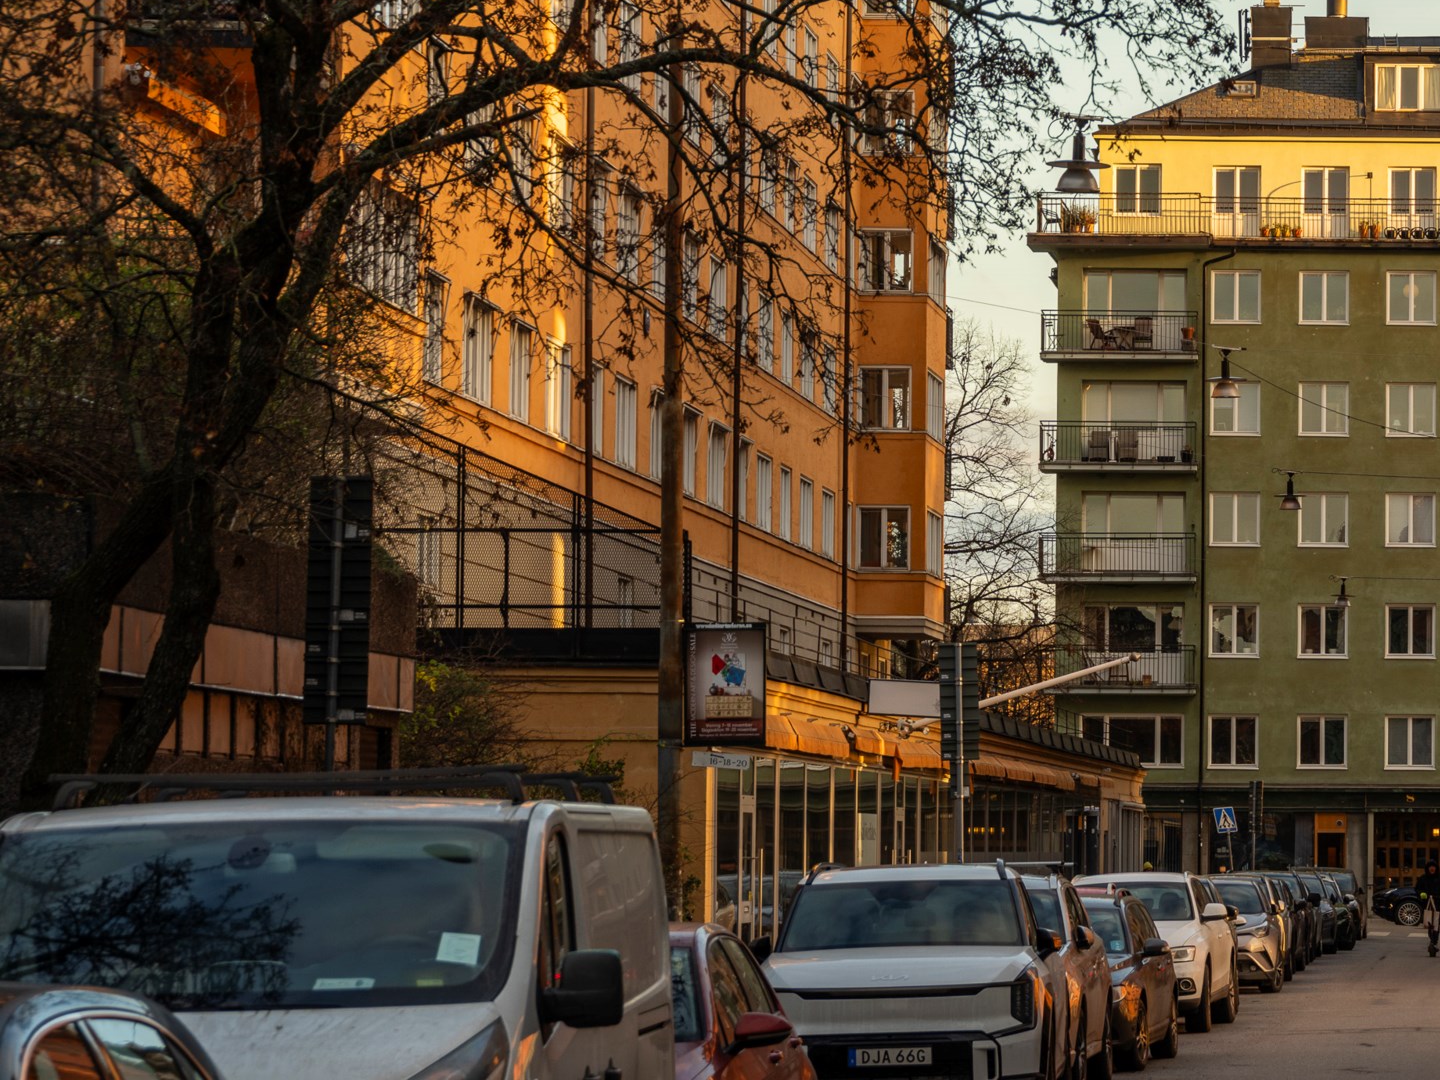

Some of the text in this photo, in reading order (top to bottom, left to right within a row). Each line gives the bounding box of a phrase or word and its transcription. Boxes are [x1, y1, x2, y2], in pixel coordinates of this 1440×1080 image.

[709, 757, 748, 768] 16-18-20
[861, 1049, 926, 1065] DJA 66G
